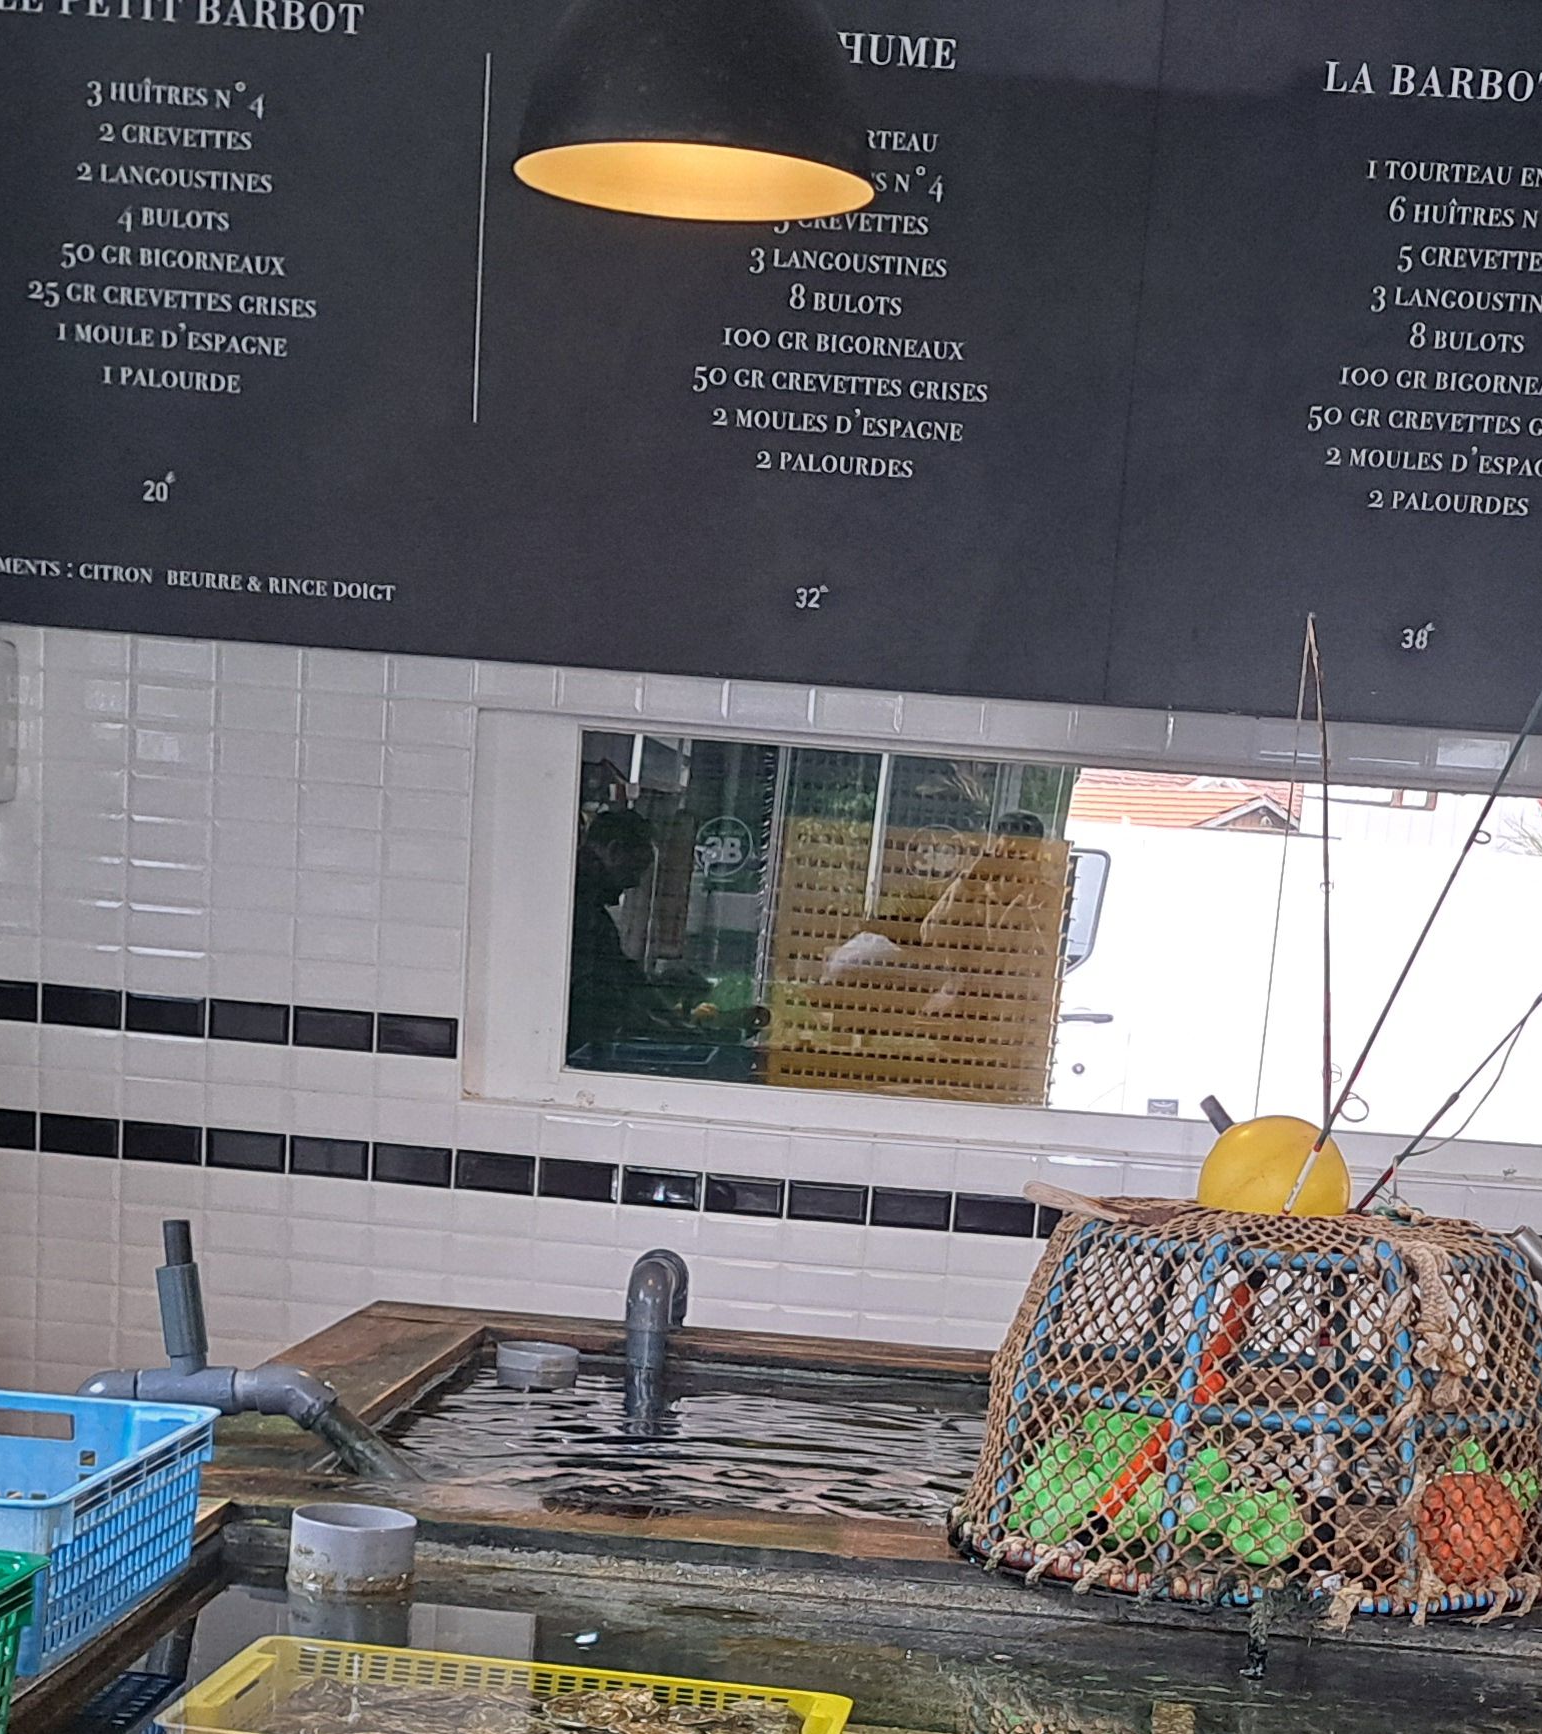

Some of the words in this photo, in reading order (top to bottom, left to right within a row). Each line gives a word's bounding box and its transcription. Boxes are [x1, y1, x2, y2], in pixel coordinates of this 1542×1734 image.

[196, 0, 365, 35] BARBOT
[86, 80, 103, 107] 3
[110, 77, 209, 107] HUÎTRES
[1322, 60, 1376, 94] LA
[99, 122, 116, 142] 2
[121, 123, 252, 151] CREVETTES
[866, 129, 939, 153] RTEAU
[76, 162, 93, 181] 2
[100, 163, 273, 194] LANGOUSTINES
[1384, 160, 1513, 186] TOURTEAU
[117, 206, 132, 233] 4
[141, 206, 230, 232] BULOTS
[1389, 195, 1407, 223] 6
[1413, 197, 1515, 228] HUÎTRES
[60, 242, 95, 269] 50
[101, 244, 132, 266] GR
[139, 247, 285, 276] BIGORNEAUX
[749, 247, 765, 274] 3
[773, 248, 947, 278] LANGOUSTINES
[1396, 245, 1413, 273] 5
[28, 280, 60, 308] 25
[66, 282, 97, 304] GR
[102, 285, 233, 313] CREVETTES
[238, 295, 317, 319] GRISES
[789, 283, 806, 310] 8
[813, 292, 902, 316] BULOTS
[1370, 285, 1386, 313] 3
[75, 323, 154, 348] MOULE
[161, 322, 288, 357] D'ESPAGNE
[722, 327, 771, 349] 100
[777, 330, 809, 352] GR
[816, 333, 965, 361] BIGORNEAUX
[1409, 321, 1426, 349] 8
[1433, 330, 1525, 354] BULOTS
[120, 366, 241, 394] PALOURDE
[692, 366, 727, 392] 50
[733, 368, 766, 389] GR
[771, 371, 902, 398] CREVETTES
[909, 380, 988, 403] GRISES
[1338, 366, 1389, 388] 100
[1396, 369, 1427, 390] GR
[711, 407, 728, 426] 2
[736, 408, 828, 433] MOULES
[835, 408, 964, 442] D'ESPAGNE
[1307, 405, 1343, 432] 50
[1350, 407, 1381, 428] GR
[1388, 409, 1521, 435] CREVETTES
[755, 450, 772, 469] 2
[779, 451, 914, 479] PALOURDES
[1324, 447, 1342, 466] 2
[1349, 447, 1443, 472] MOULES
[1367, 489, 1384, 509] 2
[1392, 490, 1529, 517] PALOURDES
[79, 563, 153, 584] CITRON
[167, 569, 243, 591] BEURRE
[246, 575, 262, 592] &
[268, 576, 328, 597] RINCE
[333, 581, 396, 601] DOIGT
